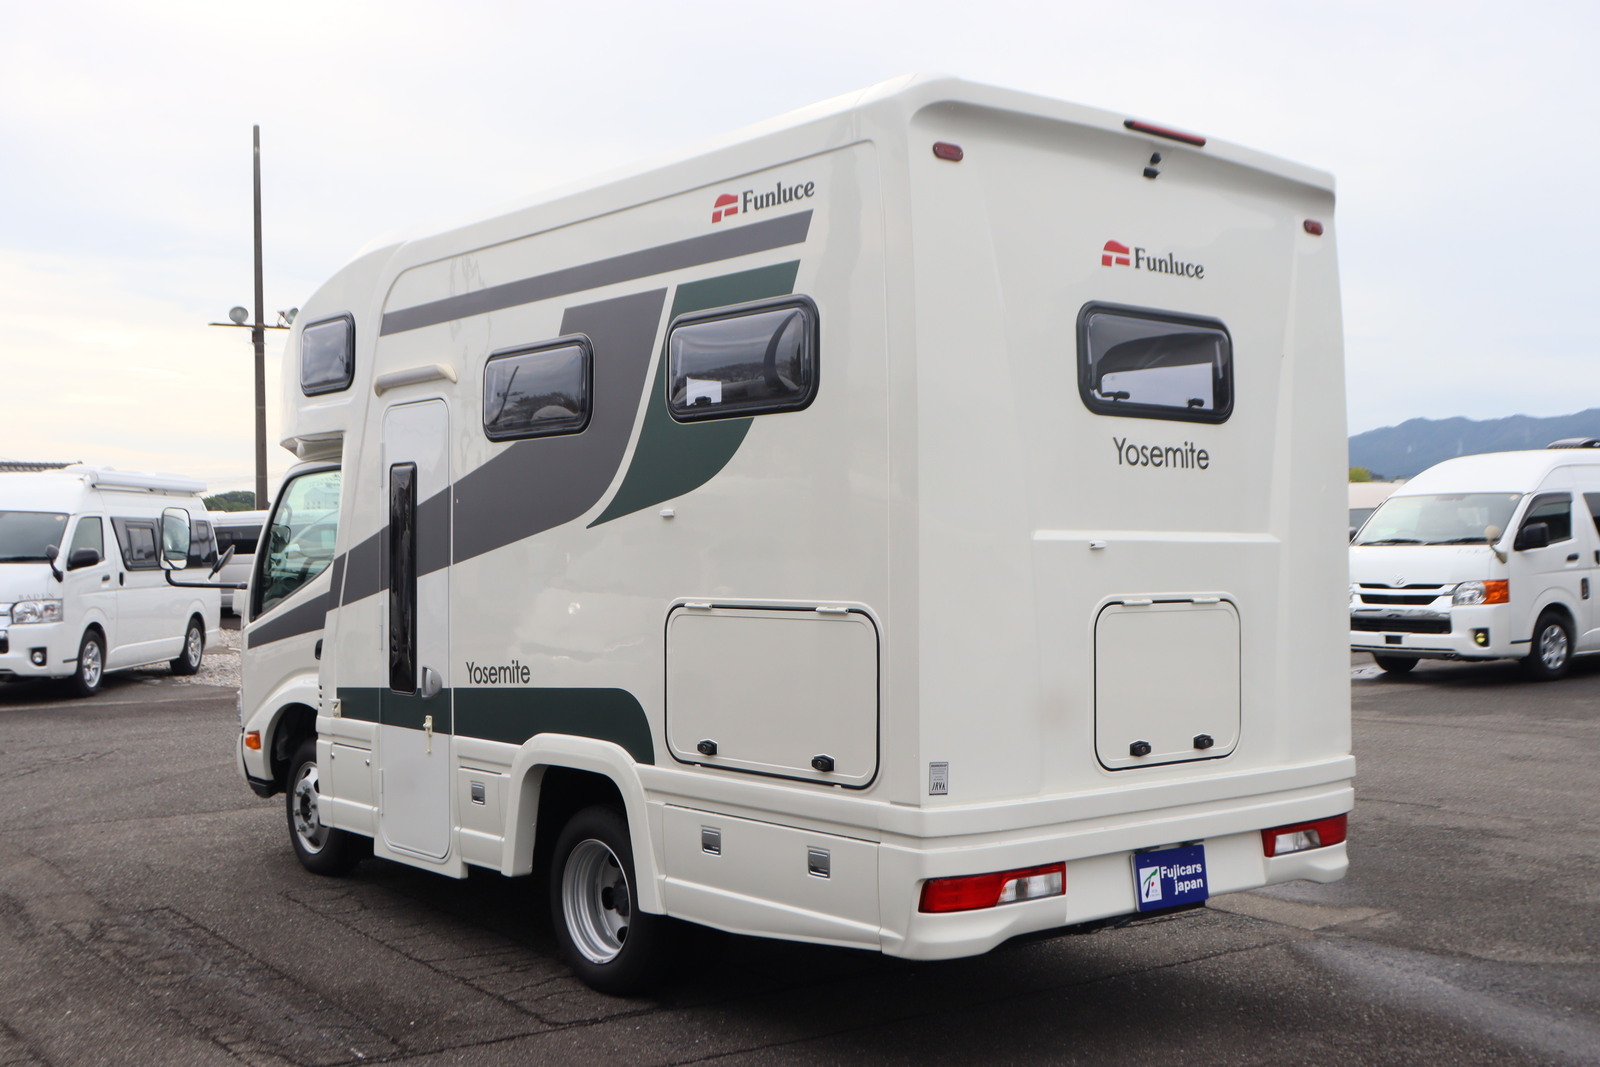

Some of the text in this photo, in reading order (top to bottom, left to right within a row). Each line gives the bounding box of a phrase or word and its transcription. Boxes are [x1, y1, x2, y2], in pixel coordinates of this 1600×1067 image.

[742, 181, 815, 214] Funluce
[1134, 246, 1205, 280] Funluce
[1112, 436, 1210, 470] Yosemite
[465, 659, 531, 684] Yosemite
[1160, 863, 1203, 880] Fujicars
[1174, 878, 1204, 896] japan
